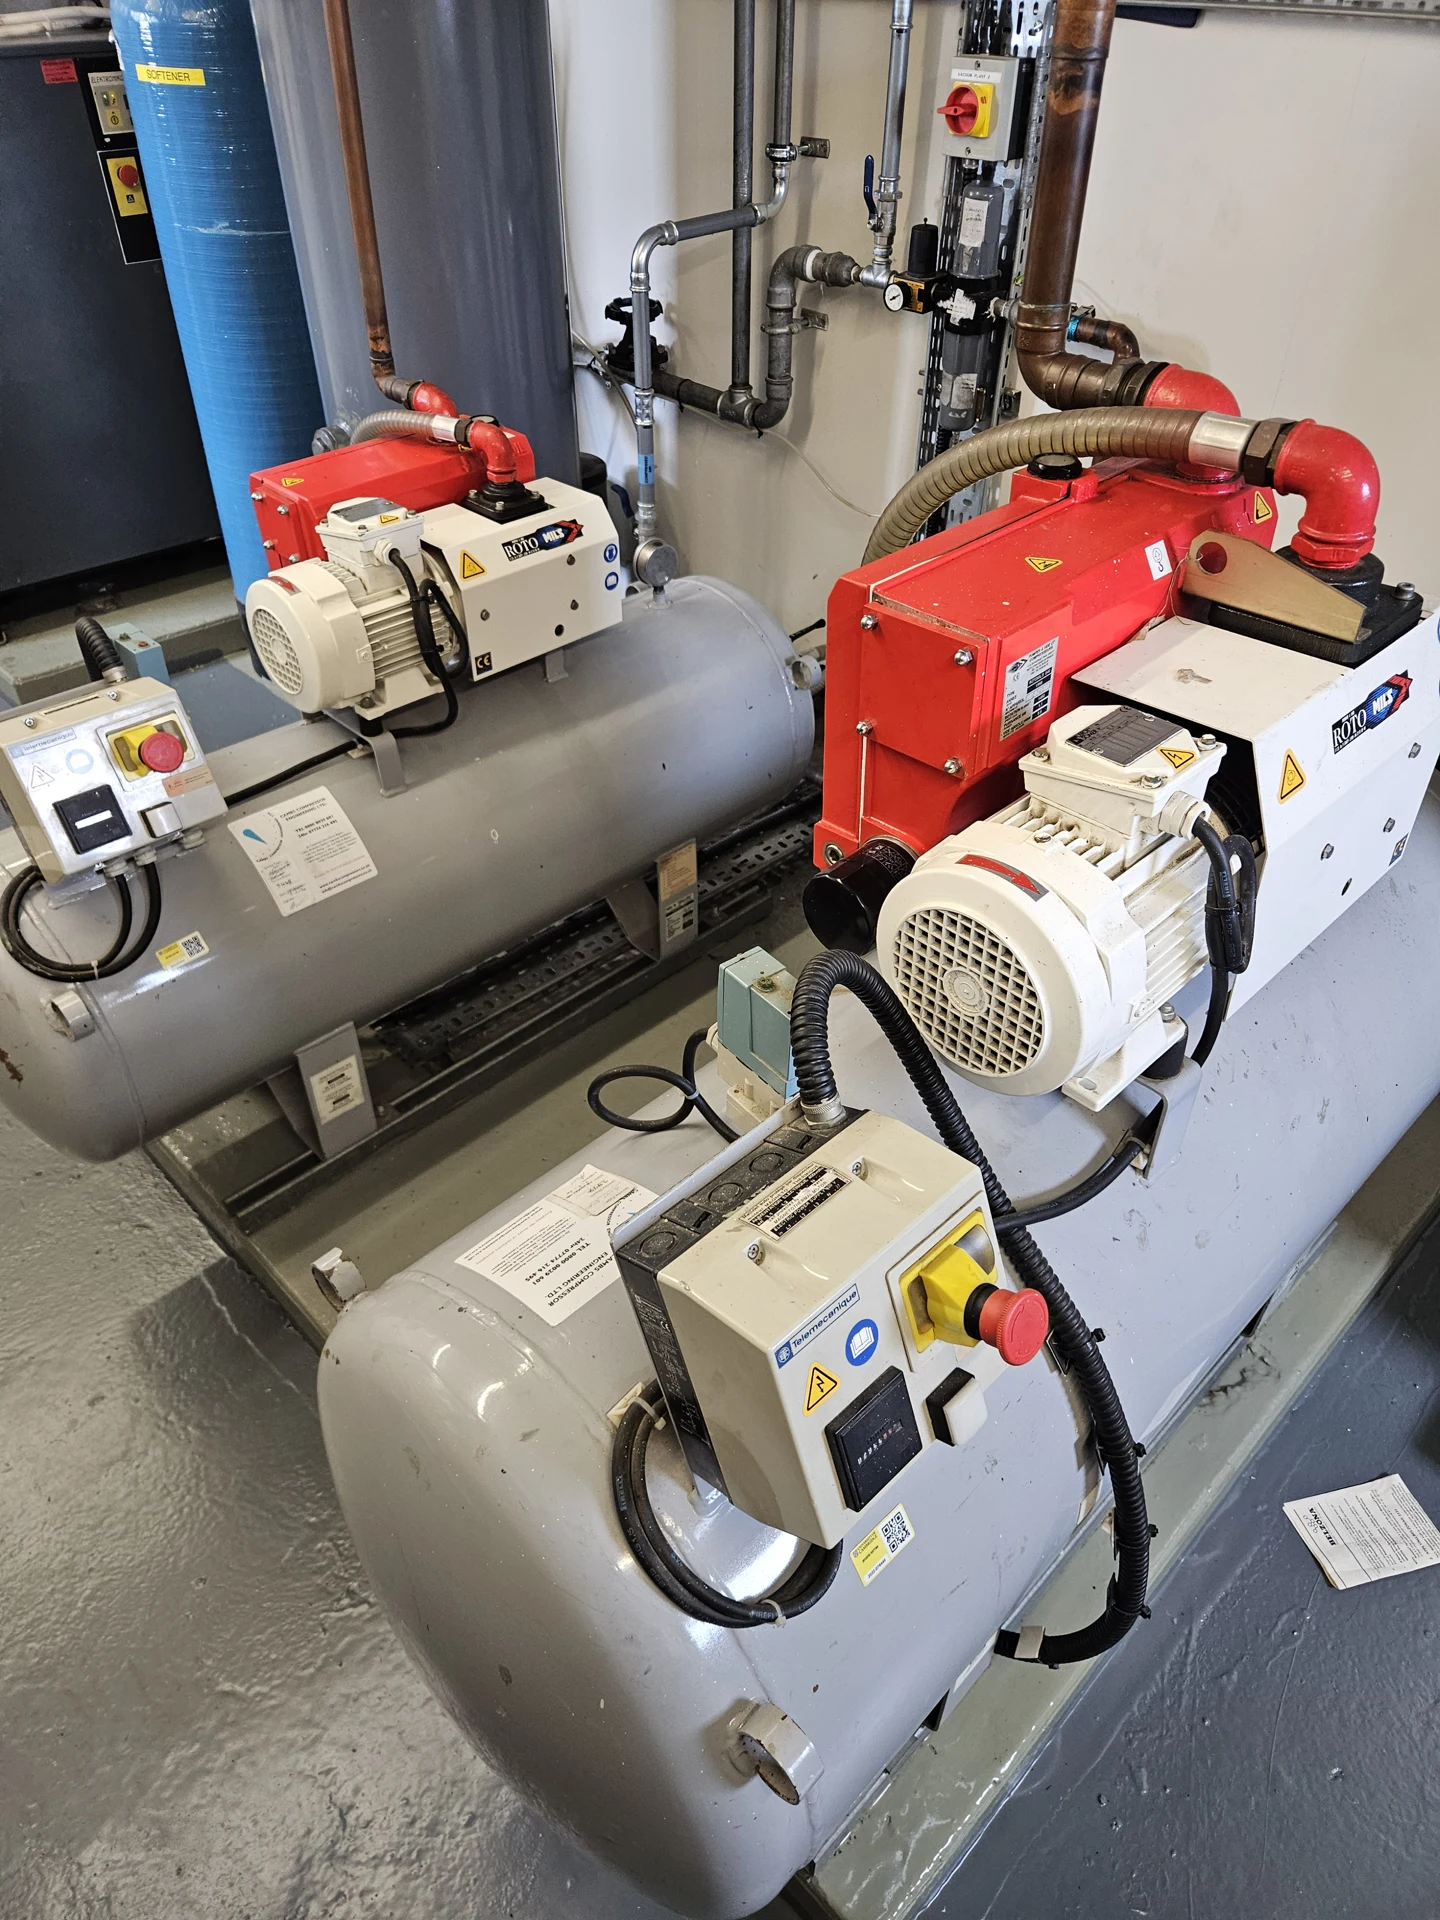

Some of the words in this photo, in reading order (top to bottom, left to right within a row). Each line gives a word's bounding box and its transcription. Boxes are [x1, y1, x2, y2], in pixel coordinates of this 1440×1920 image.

[146, 69, 191, 82] SOFTENER
[542, 527, 565, 544] MILS
[503, 537, 539, 558] ROTO
[1372, 688, 1394, 716] MILS
[1333, 709, 1367, 747] ROTO
[568, 1236, 585, 1249] 24hr
[575, 1241, 591, 1252] TEL
[549, 1247, 570, 1263] 07774
[559, 1251, 577, 1264] 0800
[593, 1254, 615, 1272] AMBS
[523, 1271, 538, 1282] 495
[543, 1262, 561, 1276] 0029
[560, 1251, 609, 1287] ENGINEERING
[531, 1275, 545, 1285] 601
[546, 1270, 595, 1306] COMPRESSOR
[543, 1285, 562, 1299] LTD.
[792, 1291, 857, 1348] Telemecanique
[1308, 1507, 1336, 1546] BELZONA
